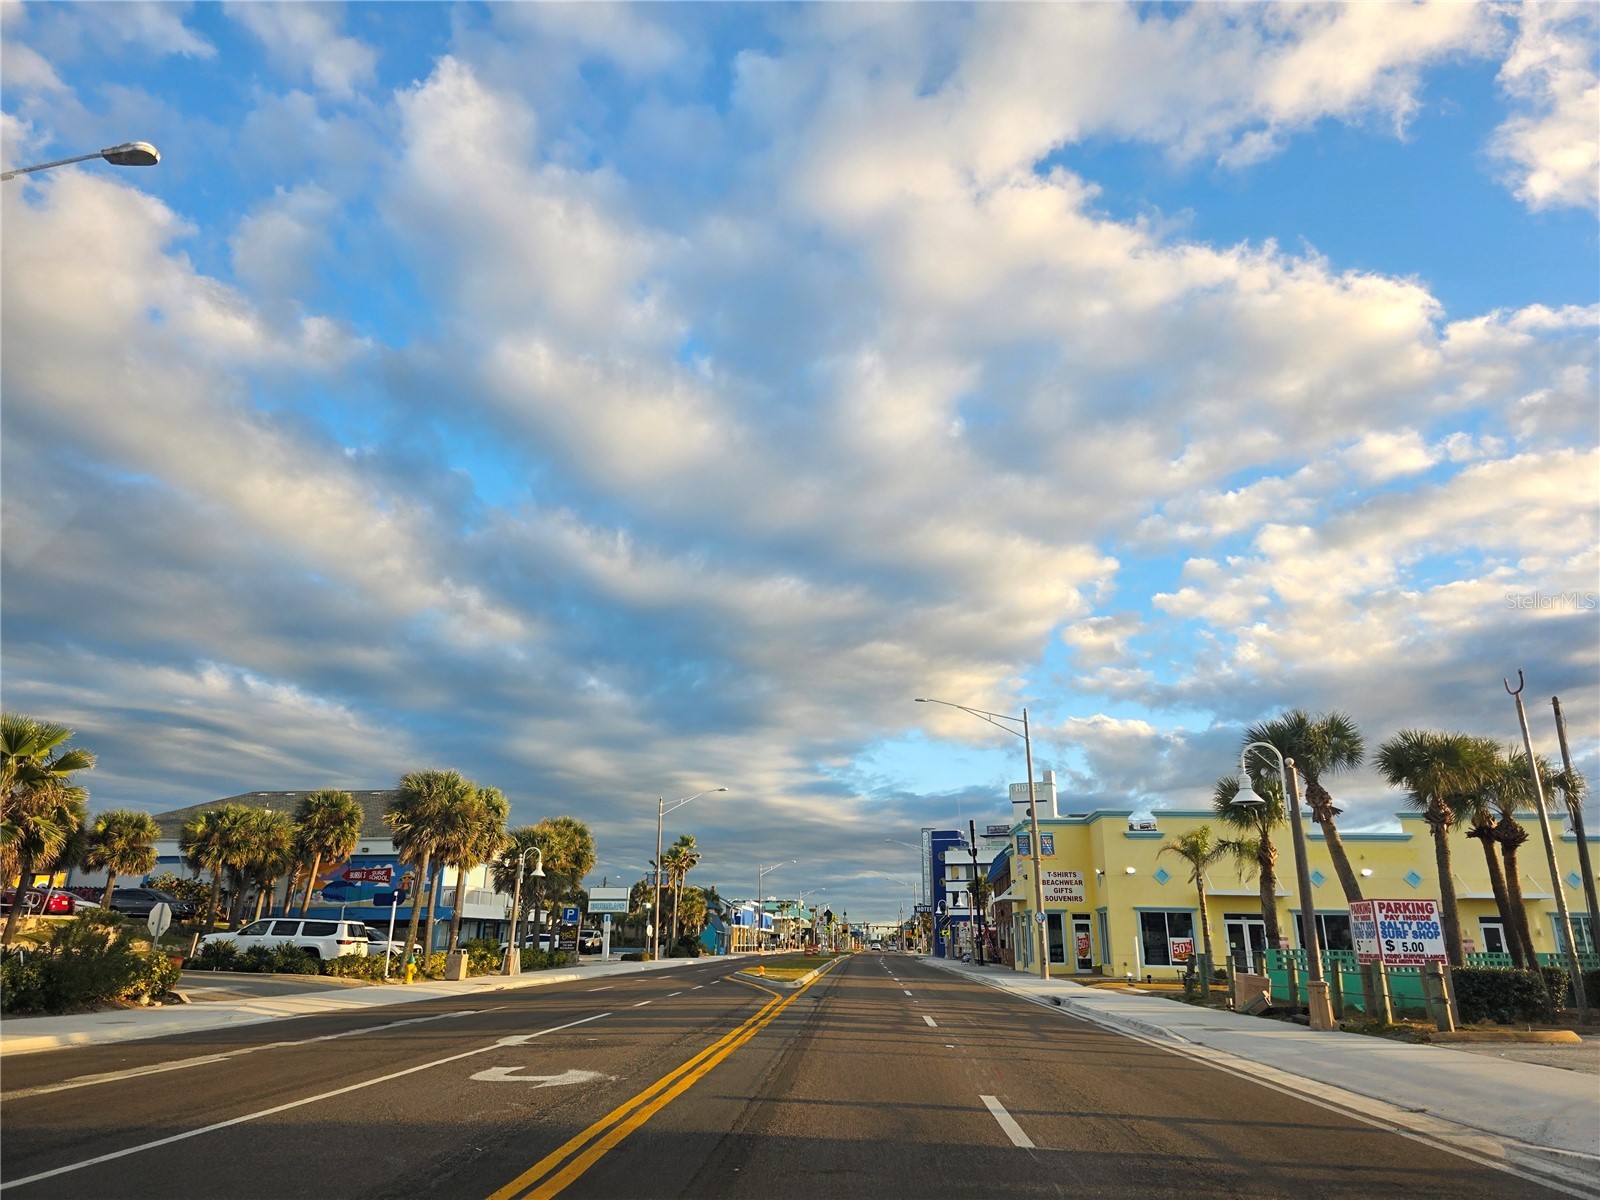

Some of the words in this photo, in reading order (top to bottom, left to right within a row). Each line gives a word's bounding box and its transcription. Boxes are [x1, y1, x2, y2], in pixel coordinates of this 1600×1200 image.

[1350, 902, 1371, 915] PARKING
[1377, 902, 1435, 914] PARKING
[566, 909, 575, 919] P
[1380, 921, 1413, 931] SALTY
[1416, 921, 1439, 931] DOG
[1381, 930, 1409, 940] SURF
[1412, 930, 1441, 940] SHOP
[1078, 939, 1089, 950] 50%
[1173, 942, 1191, 954] 50%
[1385, 939, 1395, 953] $
[1402, 942, 1424, 952] 5.00
